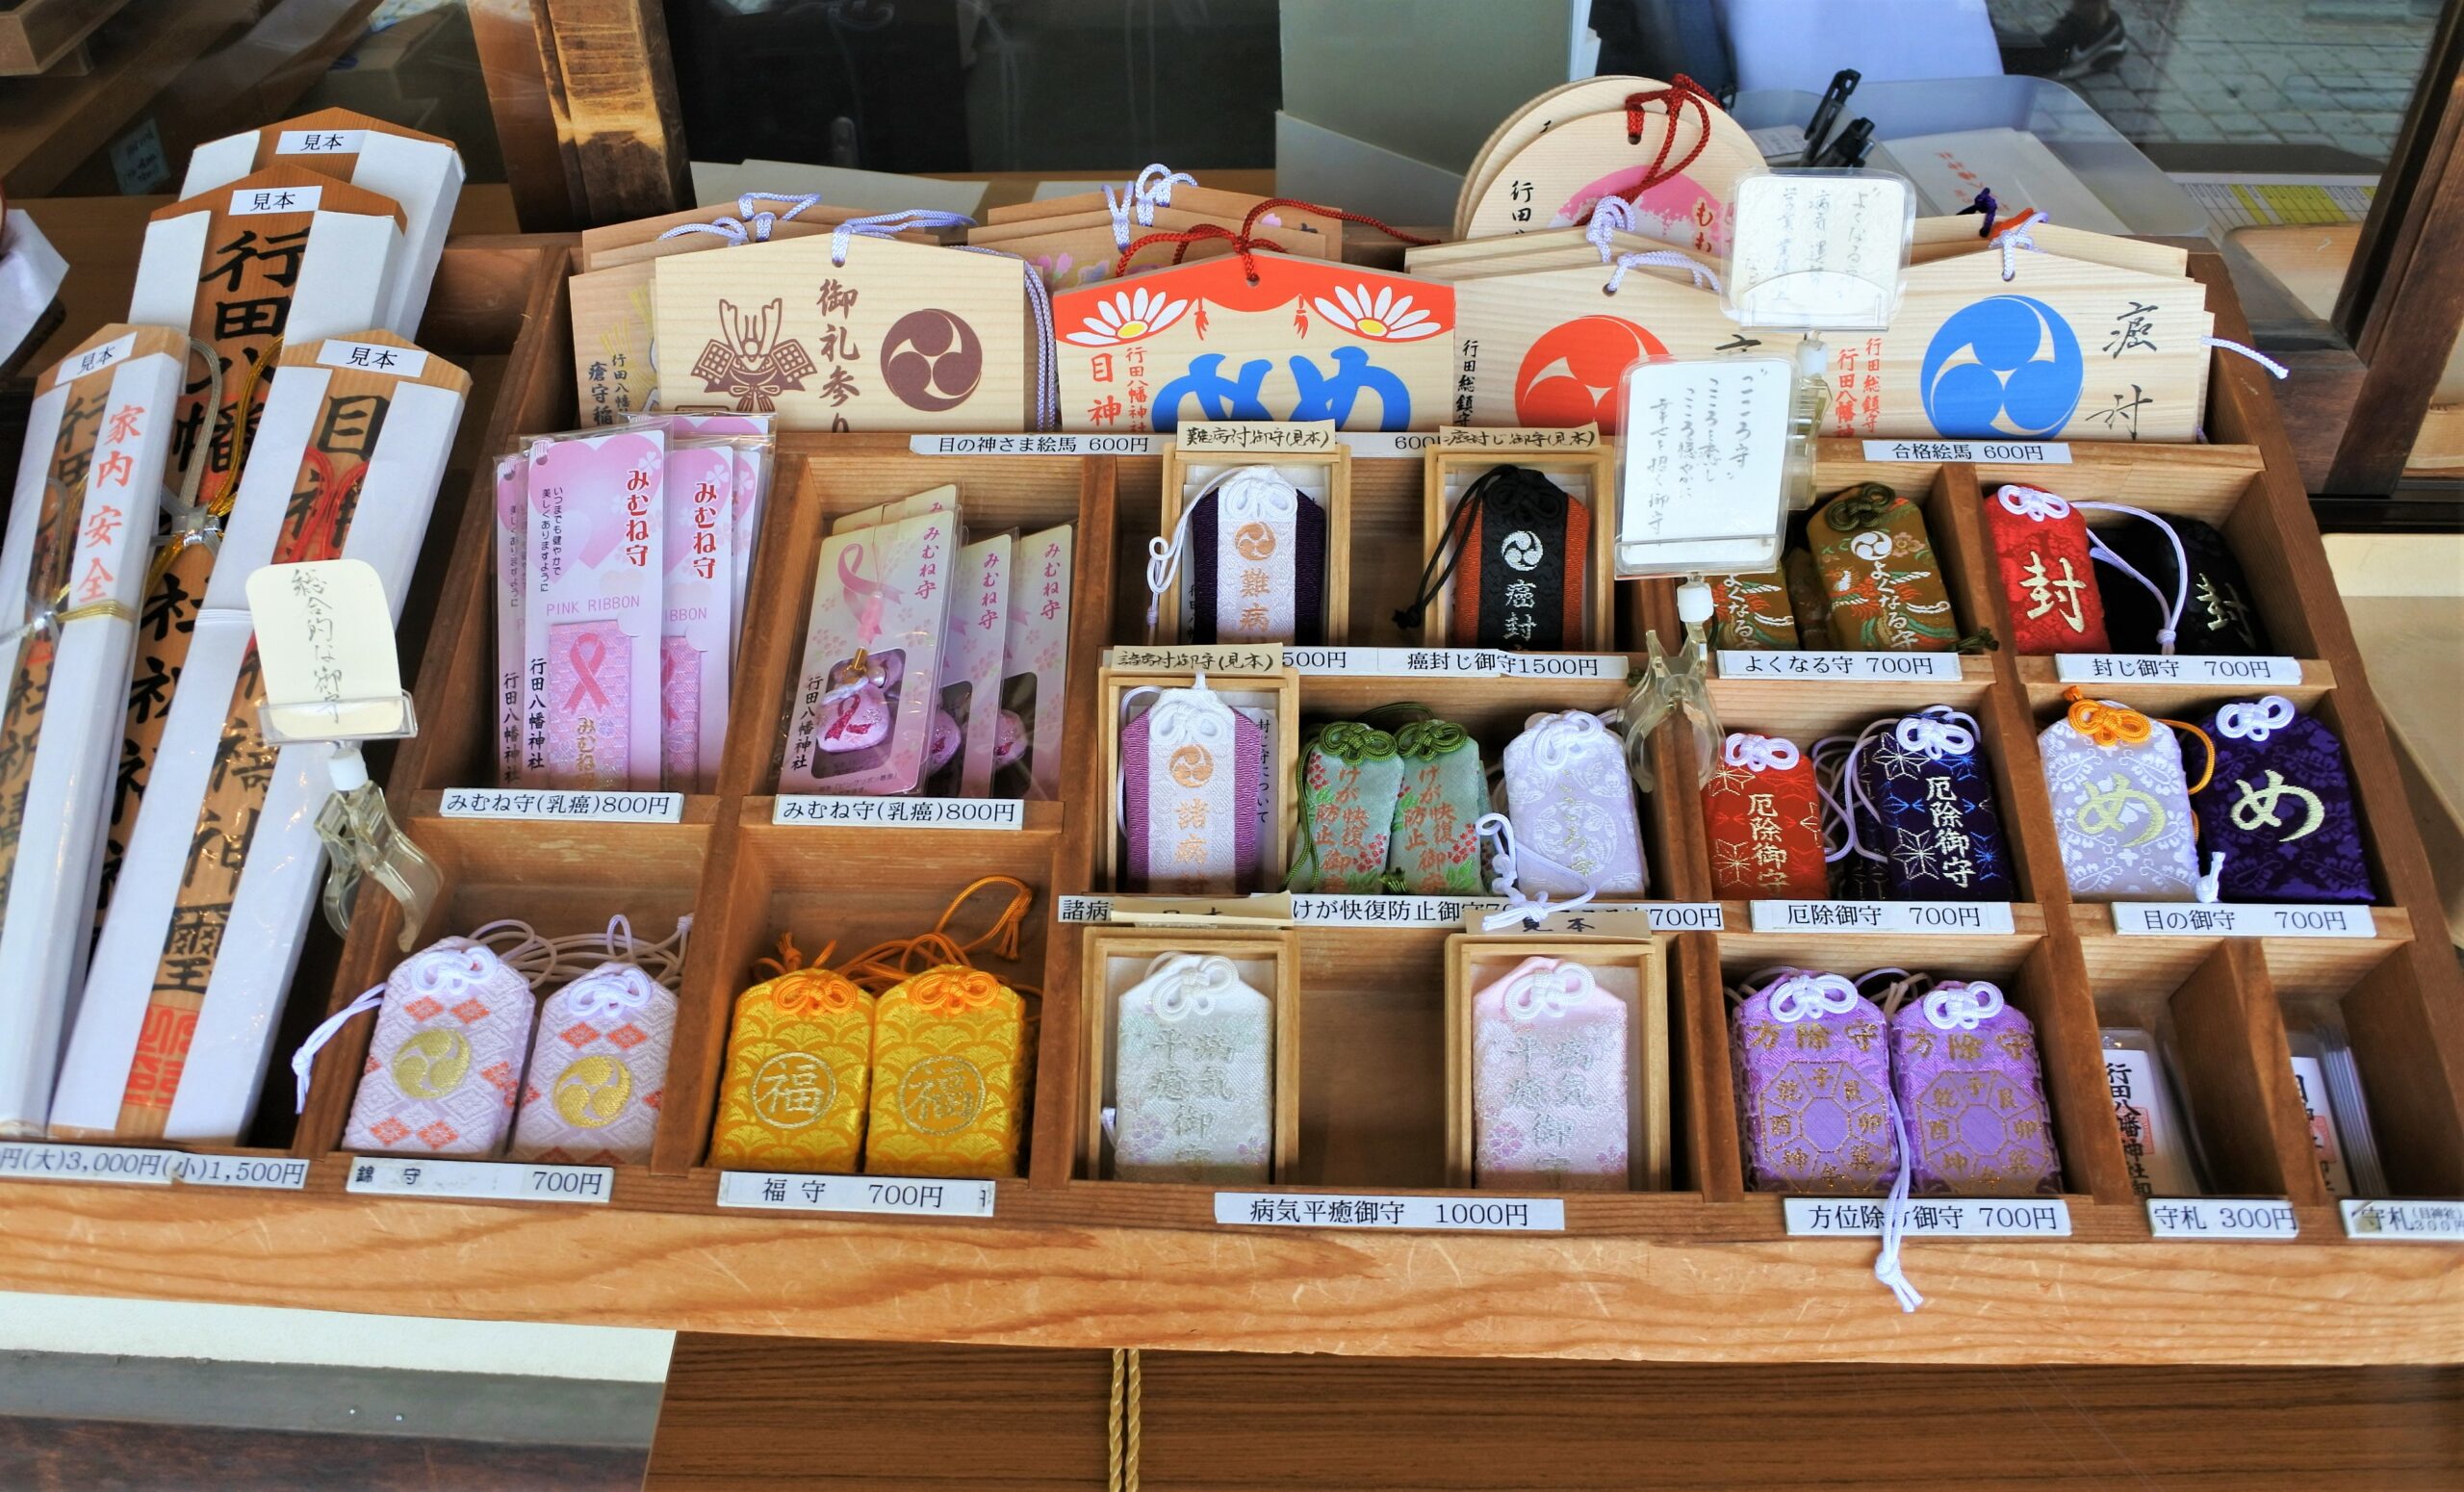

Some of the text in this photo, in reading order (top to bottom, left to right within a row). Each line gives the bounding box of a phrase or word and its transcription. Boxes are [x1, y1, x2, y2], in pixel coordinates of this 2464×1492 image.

[300, 133, 345, 151] 見本
[249, 191, 295, 212] 見本
[1510, 179, 1534, 233] 行田
[79, 345, 116, 375] 見本
[346, 347, 398, 370] 見本
[816, 278, 860, 432] 御礼参り
[611, 353, 630, 414] 行田八幡
[1088, 352, 1123, 427] 目神
[1125, 347, 1148, 432] 行田八幡神社
[1861, 337, 1883, 433] 行田総鎮守
[939, 437, 1149, 452] 目の神さま絵馬 600円
[1396, 436, 1440, 450] 600
[1890, 443, 2044, 461] 合格絵馬 600円
[77, 404, 145, 604] 家内安全
[626, 470, 649, 567] みむね守
[693, 481, 717, 579] みむね守
[914, 526, 940, 601] みむね守
[1040, 543, 1062, 620] みむね守
[546, 594, 640, 617] PINK RIBBON
[664, 607, 706, 622] IBBON
[978, 553, 1001, 630] みむね守
[1238, 568, 1270, 633] 難病
[1503, 578, 1538, 642] 癌封
[2019, 551, 2087, 633] 封
[2195, 573, 2256, 651] 封
[1745, 655, 1933, 676] よくなる守 700円
[2092, 658, 2272, 678] 封じ御守 700円
[527, 656, 547, 770] 行田八幡神社
[792, 676, 824, 770] 行田八幡神社
[447, 792, 670, 815] みむね守(乳癌)800円
[783, 801, 1015, 823] みむね守(乳癌)800円
[2075, 771, 2167, 848] め
[2231, 769, 2325, 843] め
[1748, 793, 1788, 894] 厄除御守
[1925, 776, 1977, 888] 厄除御守
[1063, 899, 1114, 922] 諸病
[1788, 905, 1981, 926] 厄除御守 700円
[2143, 910, 2348, 931] 目の御守 700円
[760, 1063, 824, 1115] 福
[909, 1065, 973, 1122] 福
[403, 1167, 422, 1184] 守
[531, 1170, 603, 1196] 700円
[762, 1178, 943, 1208] 福 守 700円
[1250, 1197, 1528, 1226] 病気平癒御守 1000円
[1979, 1207, 2057, 1229] 700円
[2154, 1205, 2297, 1231] 守札 300円
